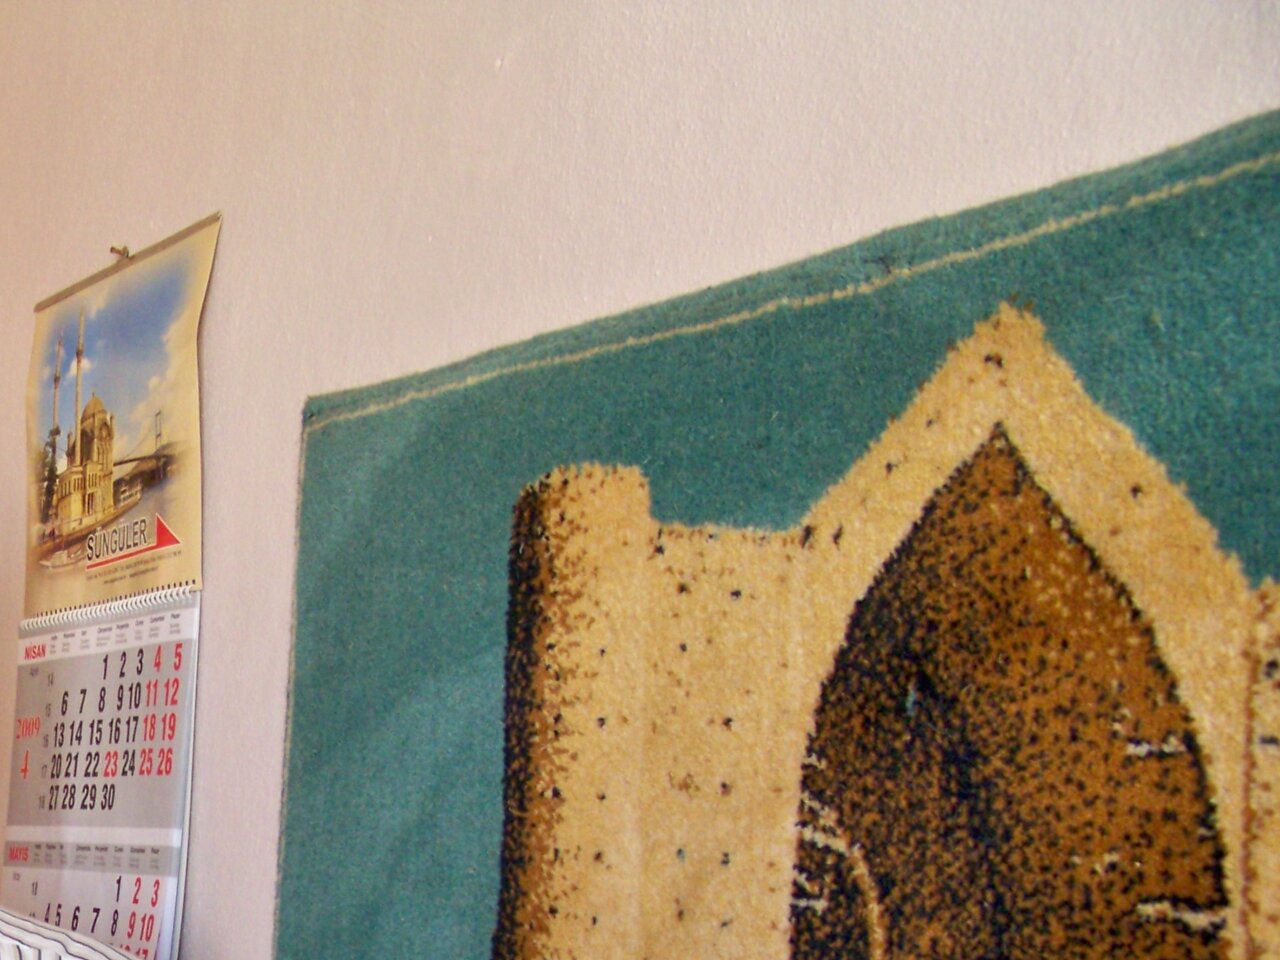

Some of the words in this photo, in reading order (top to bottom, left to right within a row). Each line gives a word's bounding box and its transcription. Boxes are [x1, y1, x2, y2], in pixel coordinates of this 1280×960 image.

[86, 518, 147, 561] SÜNGÜLER
[24, 641, 47, 661] NİSAN
[103, 655, 109, 680] 1
[119, 652, 127, 678] 2
[136, 649, 144, 675] 3
[153, 646, 162, 672] 4
[173, 643, 183, 671] 5
[61, 691, 69, 716] 6
[79, 689, 87, 714] 7
[98, 687, 106, 713] 8
[116, 685, 124, 711] 9
[128, 682, 142, 710] 10
[146, 680, 158, 707] 11
[164, 678, 179, 706] 12
[54, 722, 65, 748] 13
[69, 720, 83, 746] 14
[89, 719, 103, 745] 15
[108, 718, 121, 744] 16
[126, 716, 139, 743] 17
[143, 713, 156, 742] 18
[161, 713, 177, 741] 19
[21, 750, 30, 779] 4
[50, 753, 63, 779] 20
[64, 752, 79, 778] 21
[84, 751, 100, 778] 22
[104, 751, 118, 778] 23
[121, 749, 135, 777] 24
[139, 748, 153, 776] 25
[156, 748, 173, 777] 26
[48, 785, 60, 811] 27
[61, 784, 77, 810] 28
[80, 783, 97, 810] 29
[101, 783, 115, 810] 30
[8, 846, 30, 862] MAYIS
[116, 875, 122, 902] 1
[132, 876, 142, 904] 2
[151, 879, 160, 908] 3
[44, 903, 51, 923] 4
[55, 904, 62, 927] 5
[72, 906, 80, 931] 6
[91, 907, 100, 933] 7
[111, 909, 119, 936] 8
[127, 912, 136, 939] 9
[140, 913, 155, 942] 10
